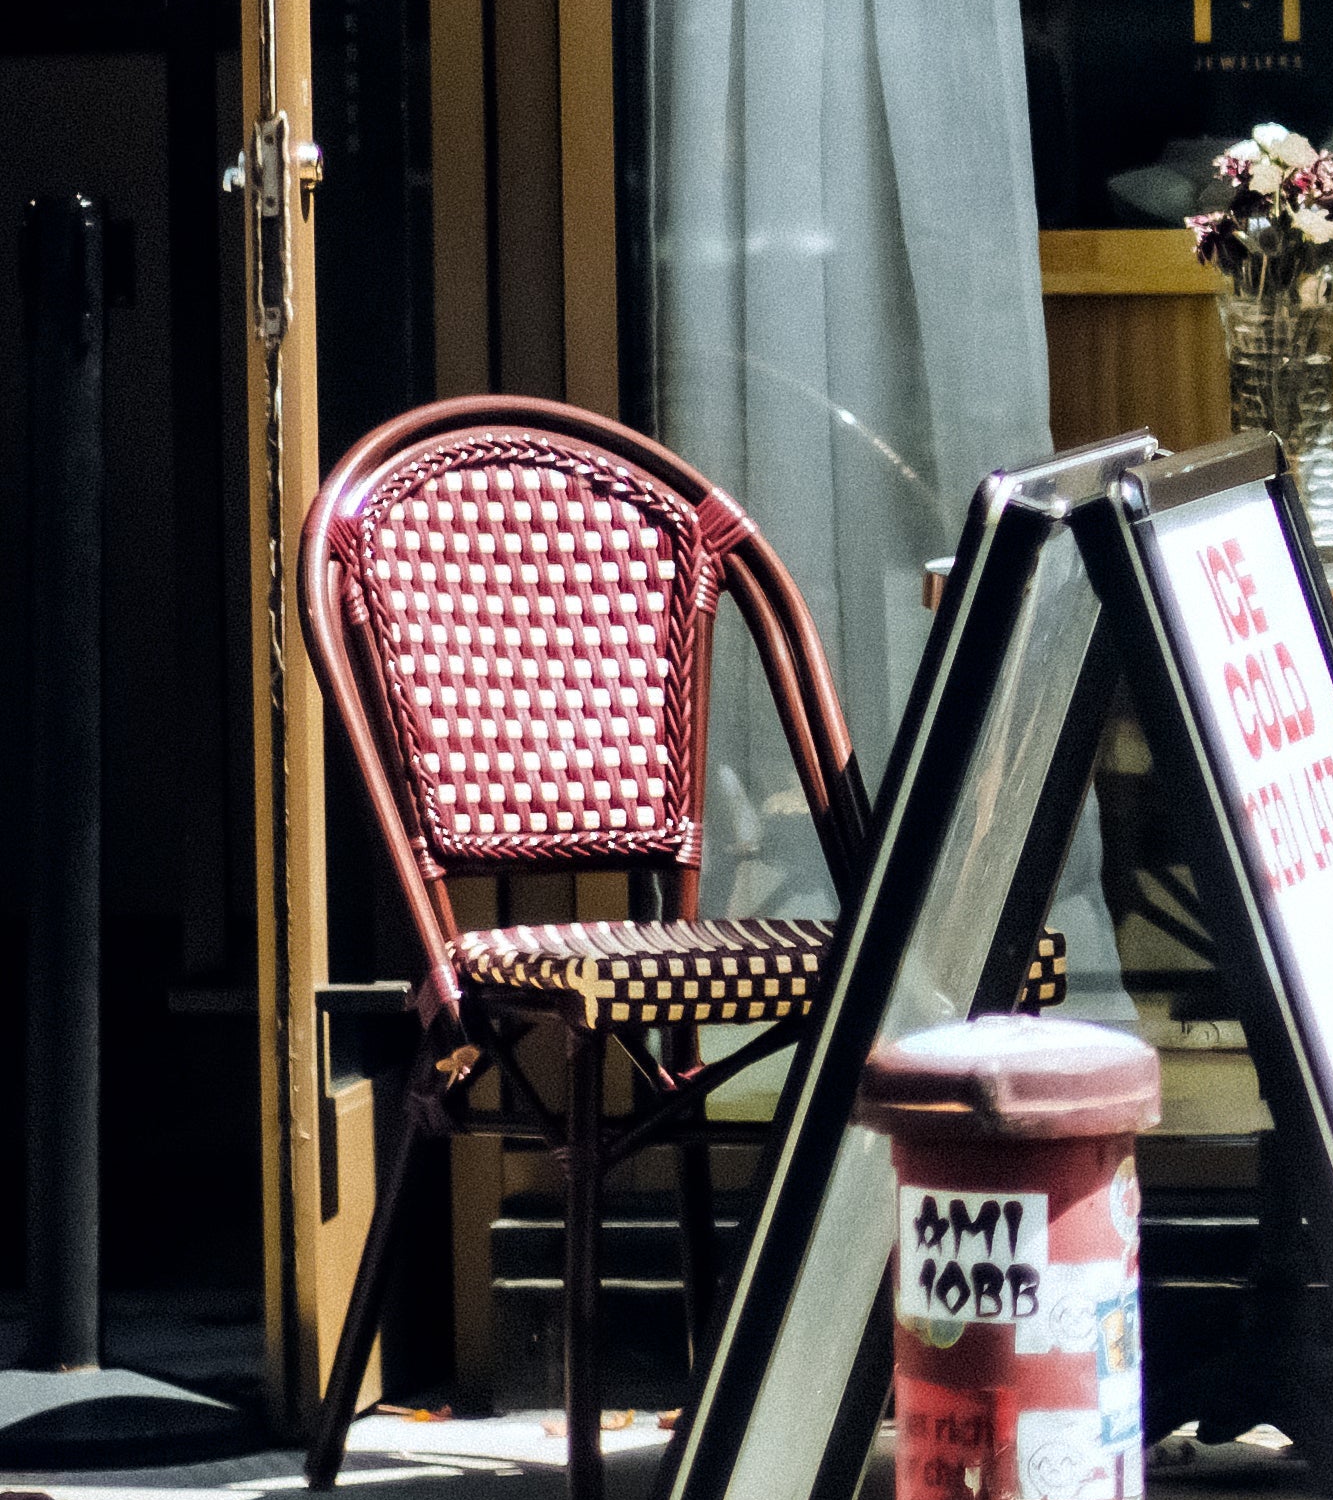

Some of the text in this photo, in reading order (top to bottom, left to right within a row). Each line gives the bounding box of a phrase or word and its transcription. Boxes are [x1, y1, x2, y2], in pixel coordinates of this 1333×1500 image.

[1197, 537, 1269, 645] ICE
[1223, 641, 1316, 762] COLD
[1244, 781, 1306, 893] CED
